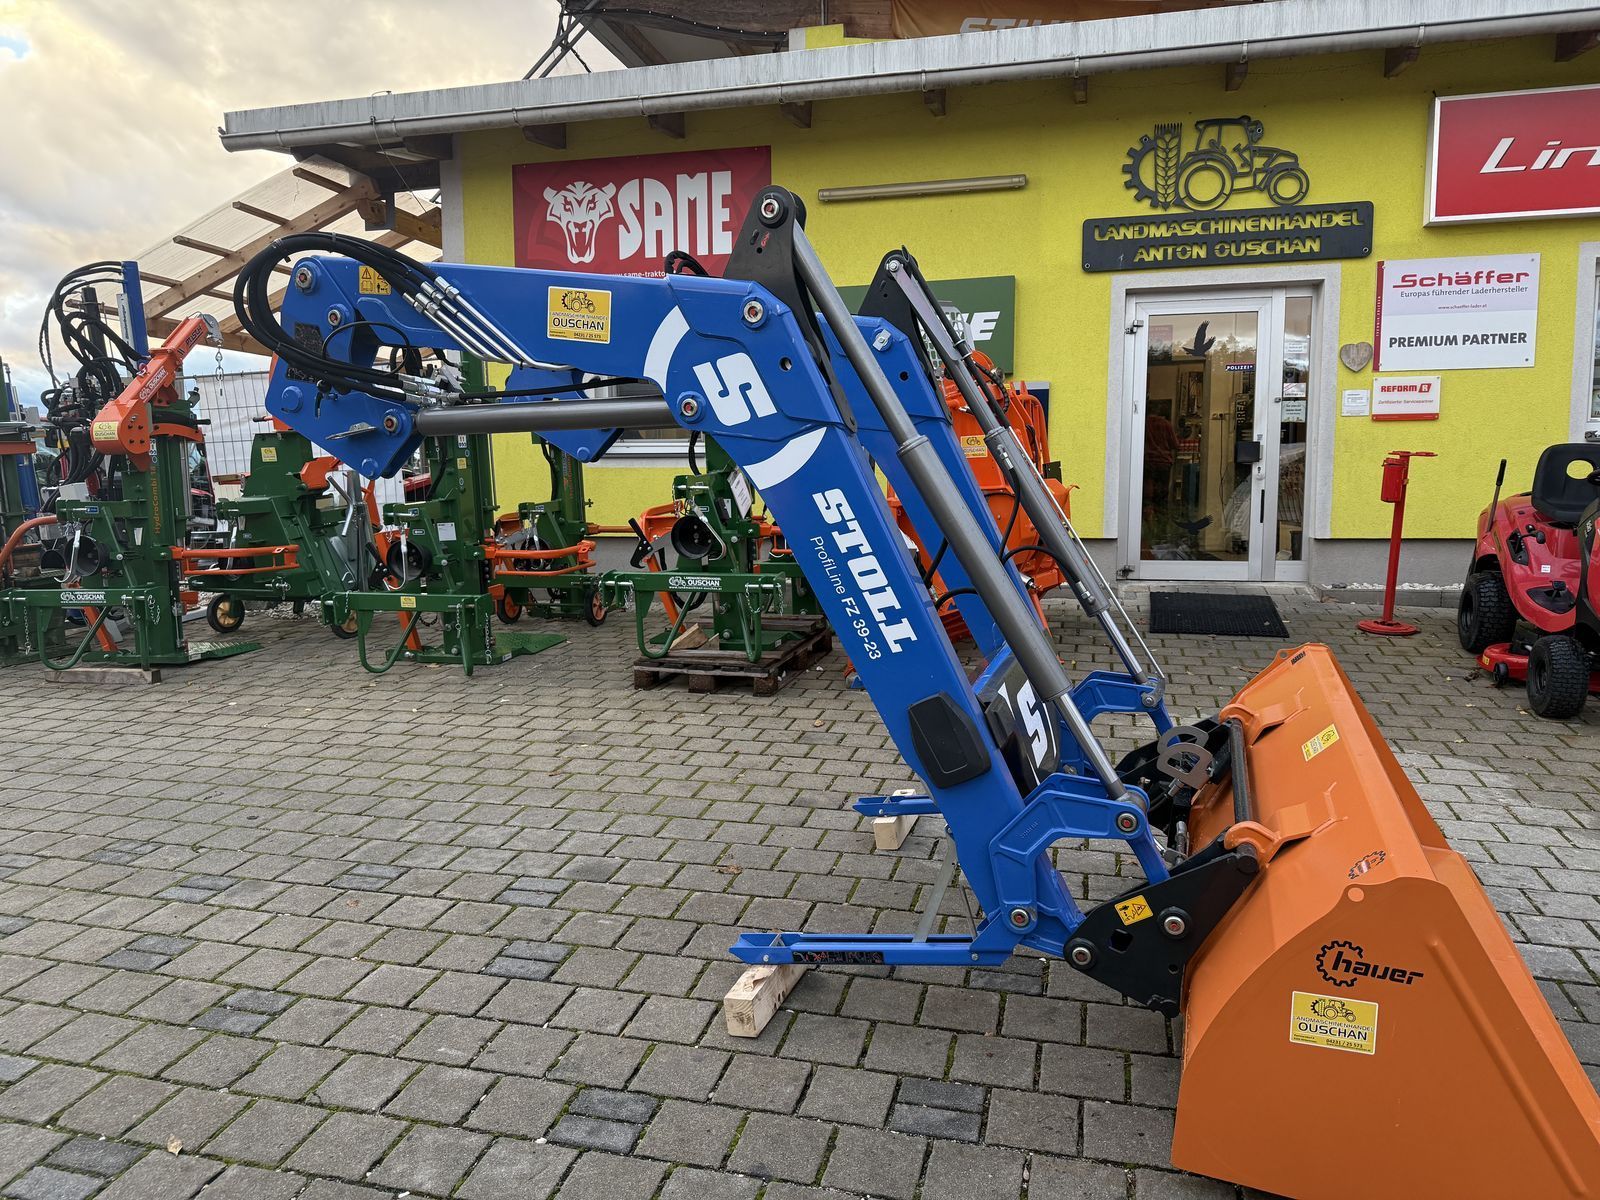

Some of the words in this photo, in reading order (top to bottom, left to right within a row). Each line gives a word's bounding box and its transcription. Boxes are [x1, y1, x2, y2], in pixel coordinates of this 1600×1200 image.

[618, 170, 733, 260] SAME
[1093, 209, 1364, 241] LANDMASCHINENHANDEL
[1133, 242, 1207, 263] ANTON
[1214, 236, 1322, 258] OUSCHAN
[1392, 270, 1530, 289] Schäffer
[1400, 290, 1431, 299] Europas
[1432, 288, 1470, 297] führender
[1471, 286, 1529, 295] Laderhersteller
[552, 317, 605, 331] OUSCHAN
[1389, 334, 1459, 348] PREMIUM
[1462, 332, 1527, 346] PARTNER
[1380, 385, 1418, 393] REFORM
[812, 488, 918, 654] STOLL
[810, 536, 846, 595] ProfiLine
[841, 596, 861, 617] FZ
[853, 618, 882, 660] 39-23
[1331, 950, 1424, 984] hauer
[1292, 1015, 1374, 1032] ANDMASCHINENHANDEL
[1298, 1022, 1367, 1041] OUSCHAN
